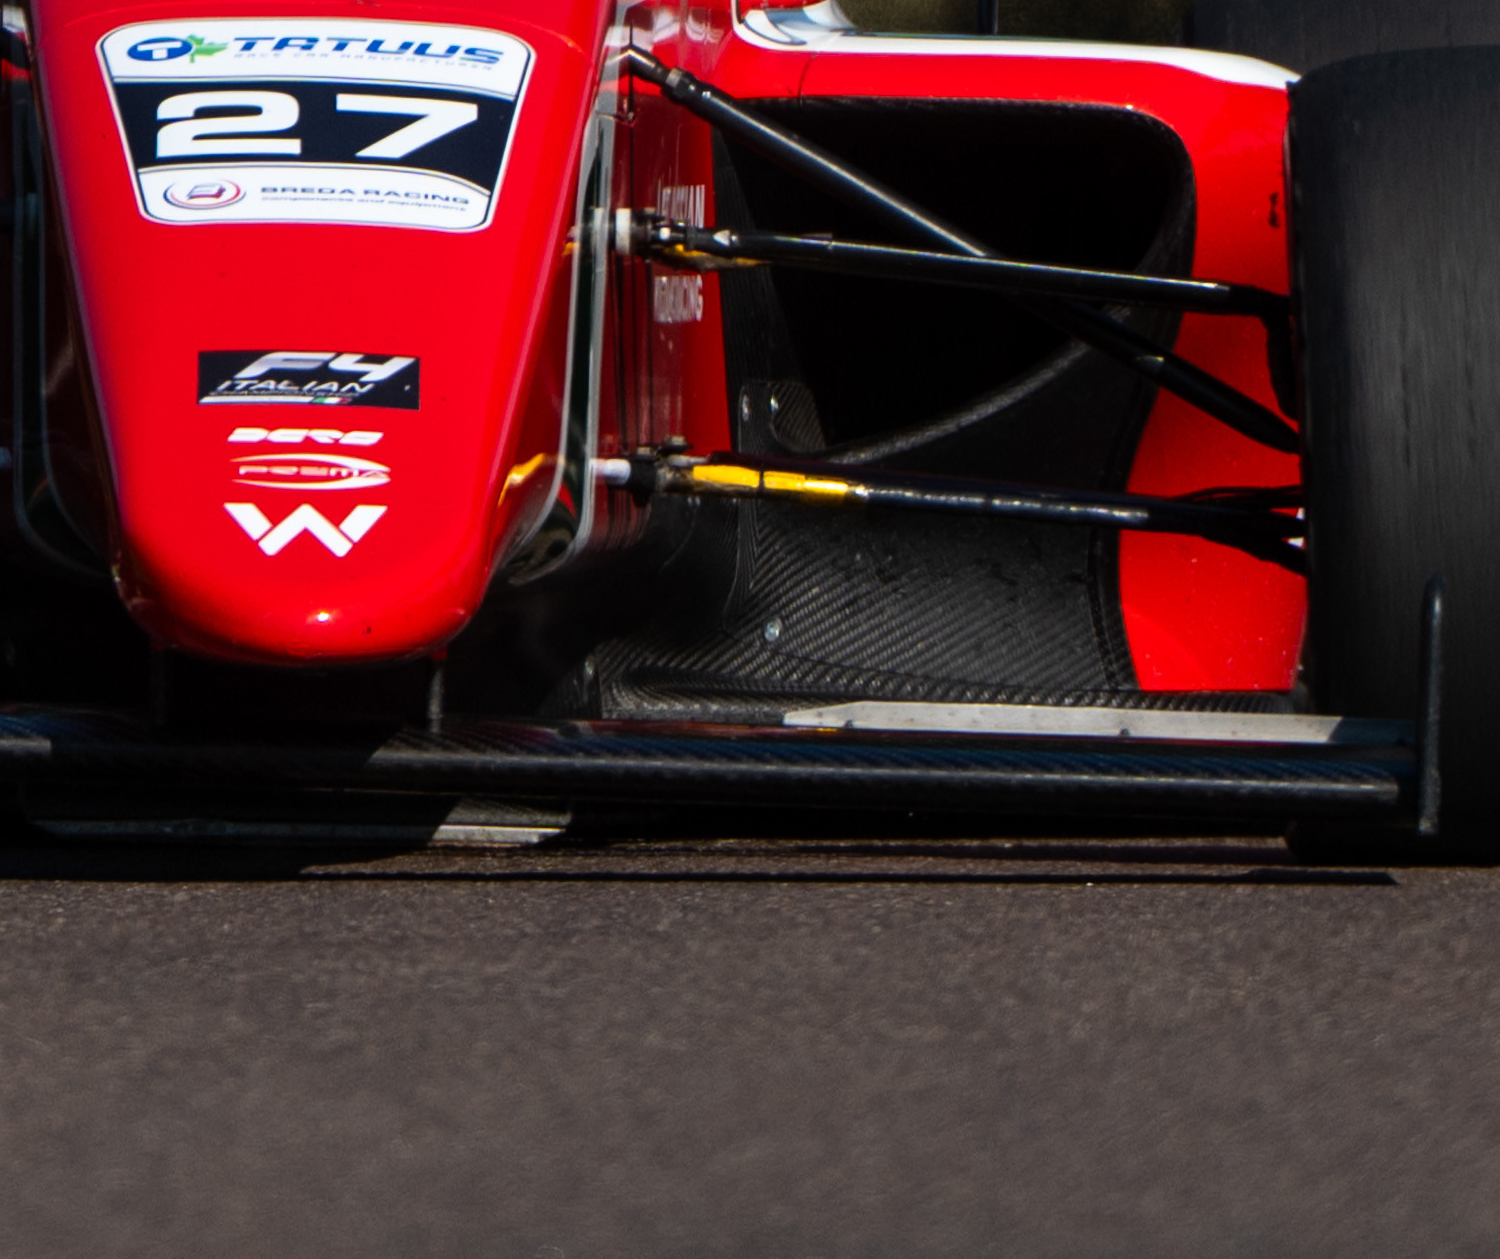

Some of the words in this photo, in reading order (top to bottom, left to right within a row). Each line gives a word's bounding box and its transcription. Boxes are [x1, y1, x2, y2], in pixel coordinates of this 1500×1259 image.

[234, 36, 504, 65] TATUUS
[156, 90, 479, 159] 27
[261, 187, 355, 195] BREDA
[363, 189, 469, 205] RACING
[234, 351, 416, 382] F4
[216, 380, 376, 393] ITALIAN
[223, 501, 389, 559] W
